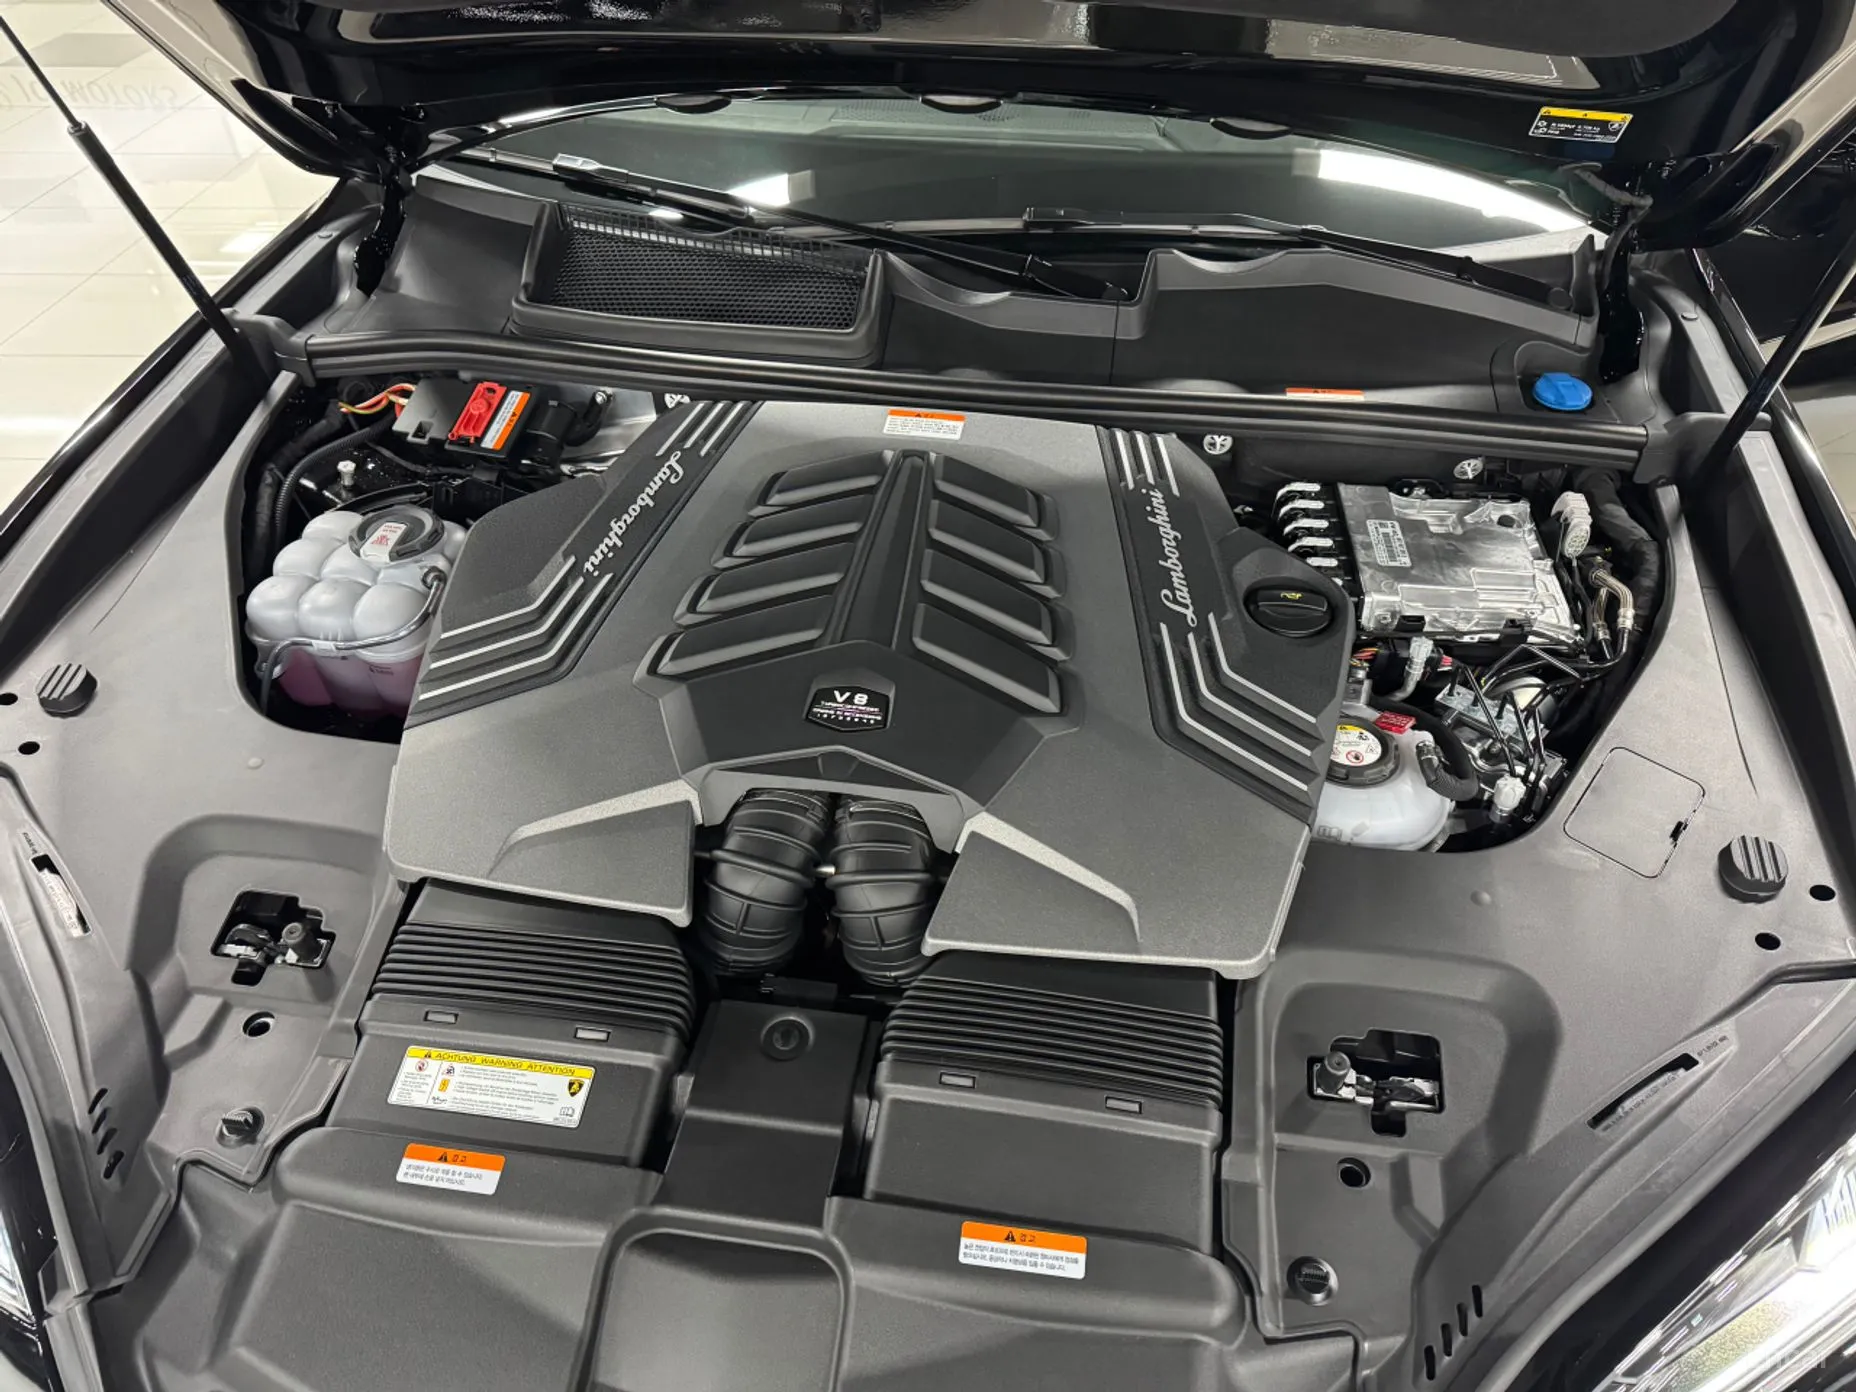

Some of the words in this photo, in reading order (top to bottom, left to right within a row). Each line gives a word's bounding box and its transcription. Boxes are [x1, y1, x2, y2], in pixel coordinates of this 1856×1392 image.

[584, 451, 684, 576] Lamborghini
[1142, 489, 1197, 628] Lamborghini
[435, 1052, 477, 1063] ACHTUNG
[481, 1057, 523, 1068] WARNING
[527, 1062, 576, 1075] ATTENTION
